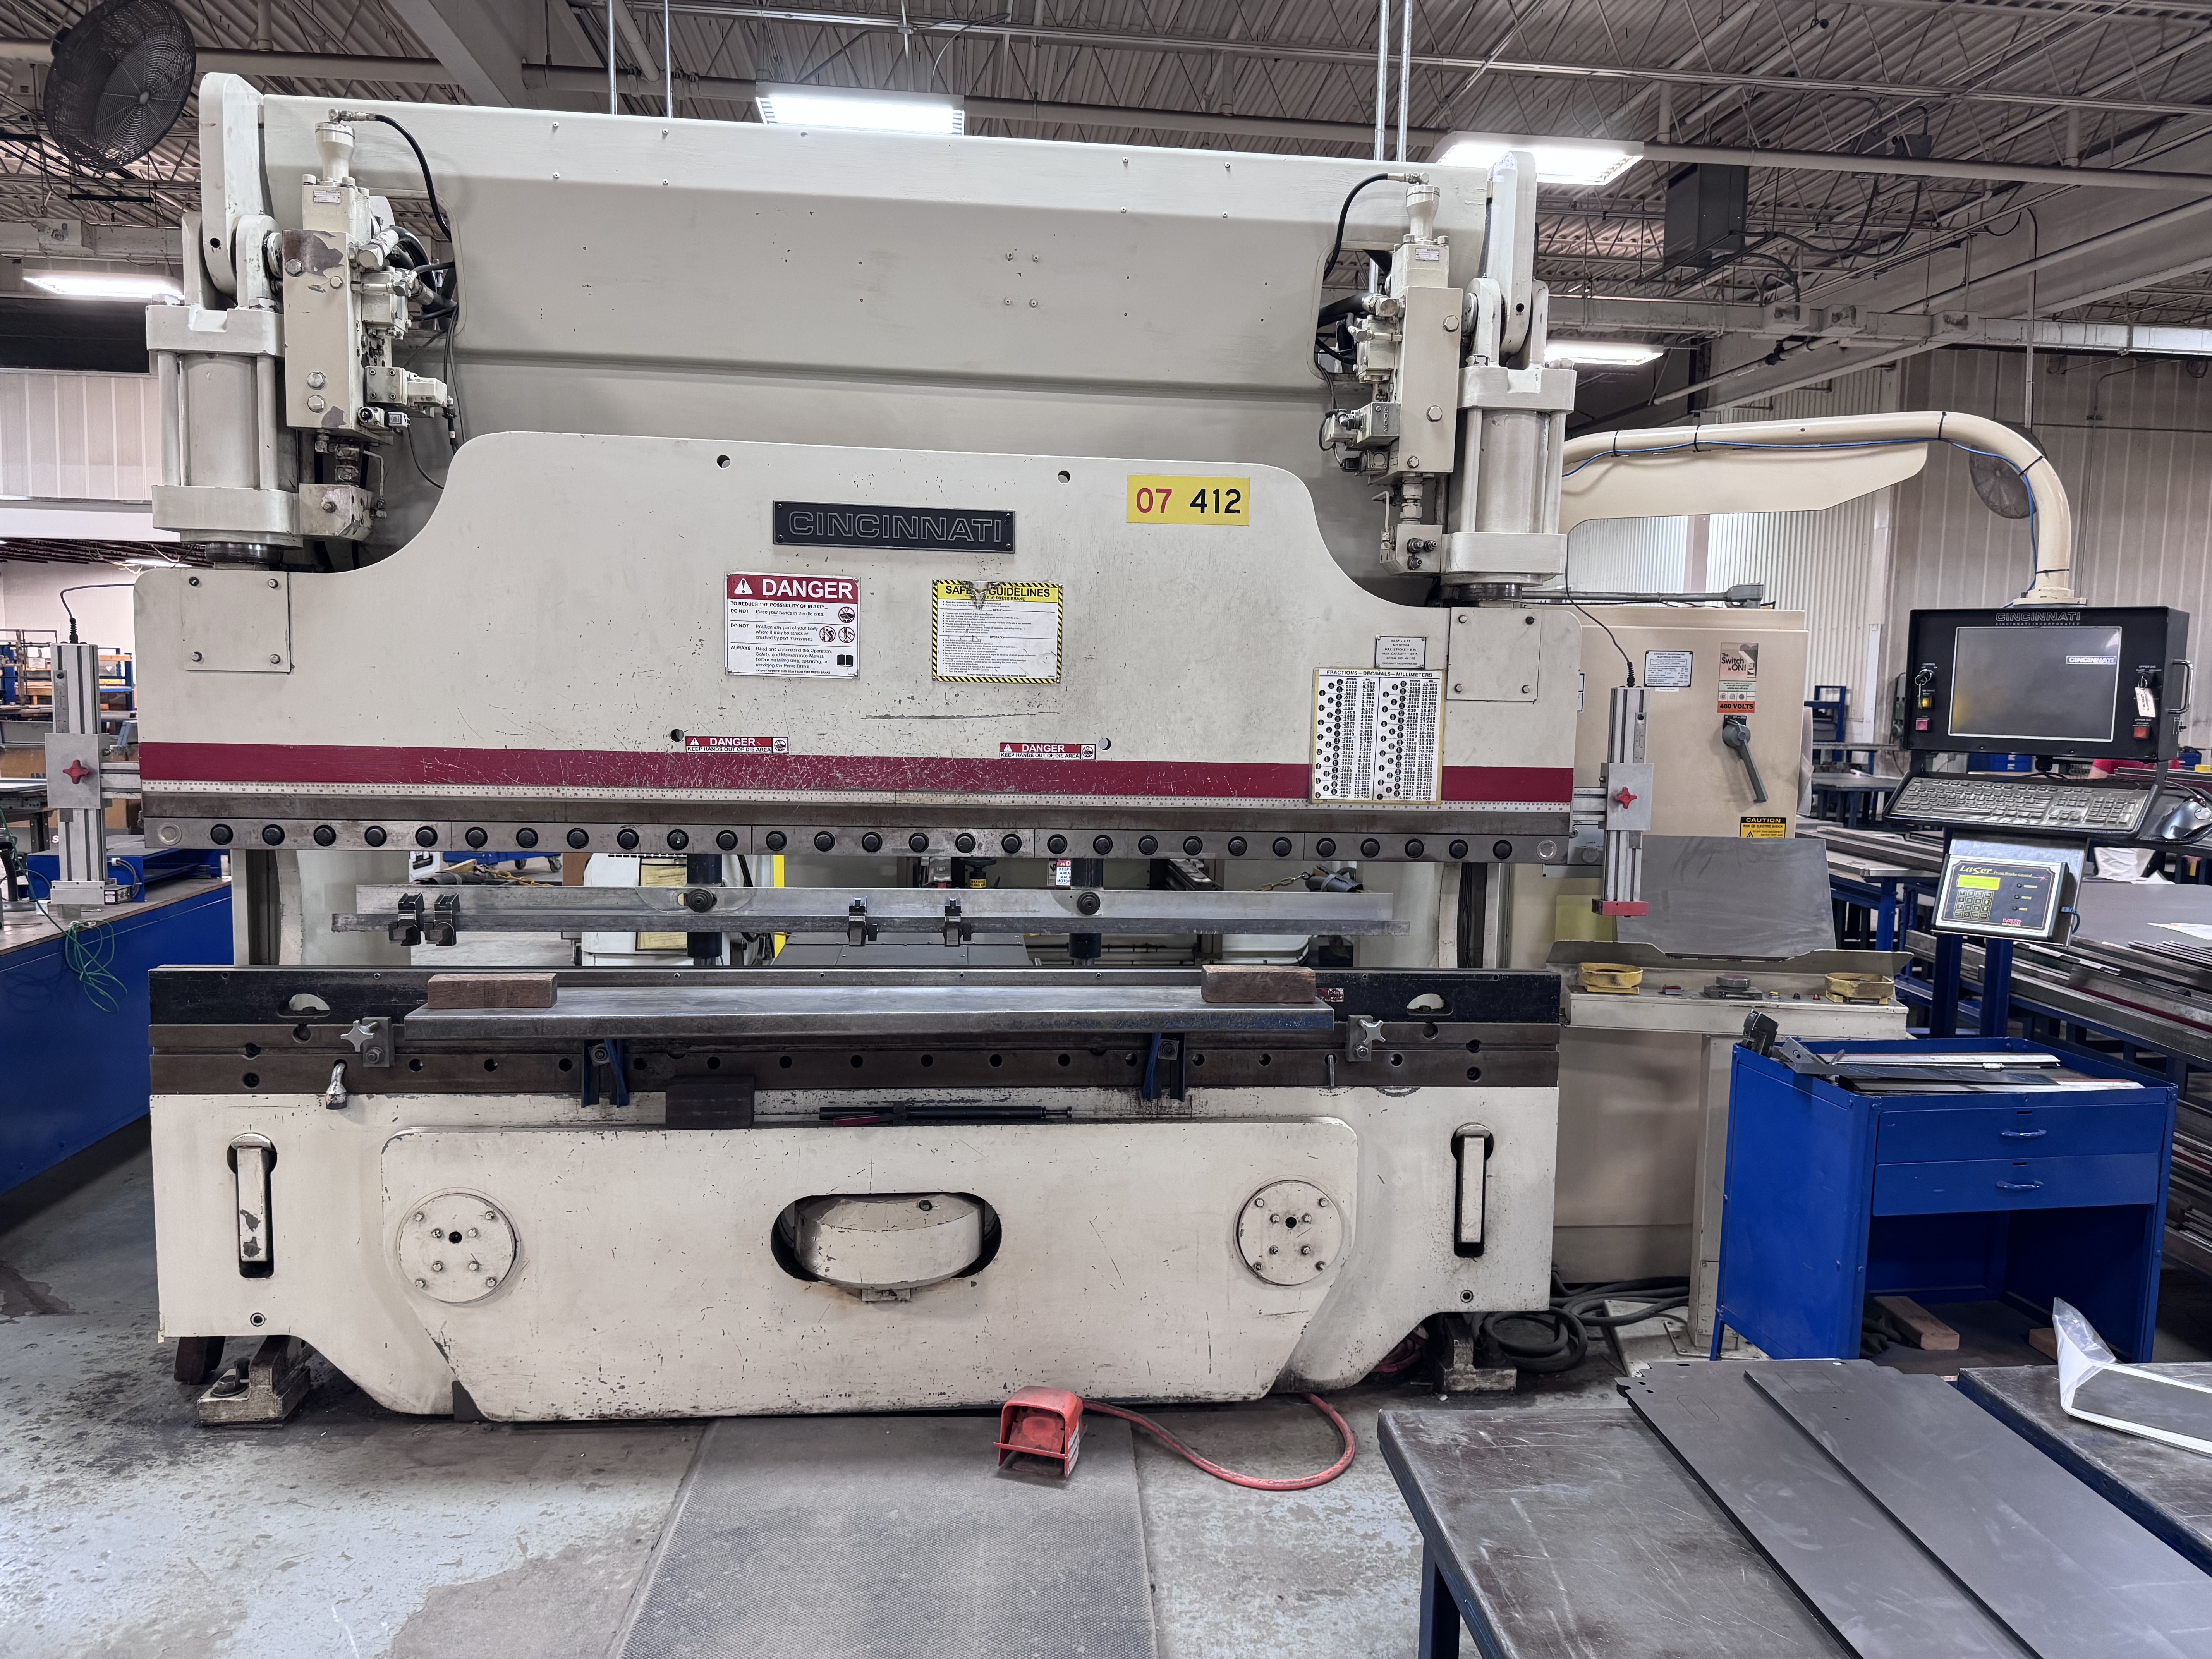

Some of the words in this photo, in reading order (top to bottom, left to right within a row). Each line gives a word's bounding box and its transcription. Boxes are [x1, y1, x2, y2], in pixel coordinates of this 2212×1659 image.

[1136, 488, 1172, 514] 07
[1190, 489, 1241, 514] 412
[789, 511, 1001, 542] CINCINNATI
[762, 579, 853, 599] DANGER
[989, 587, 1050, 597] GUIDELINES
[1996, 612, 2080, 621] CINCINNATI
[710, 737, 756, 746] DANGER
[1022, 744, 1065, 753] DANGER
[1960, 865, 1992, 874] Laser
